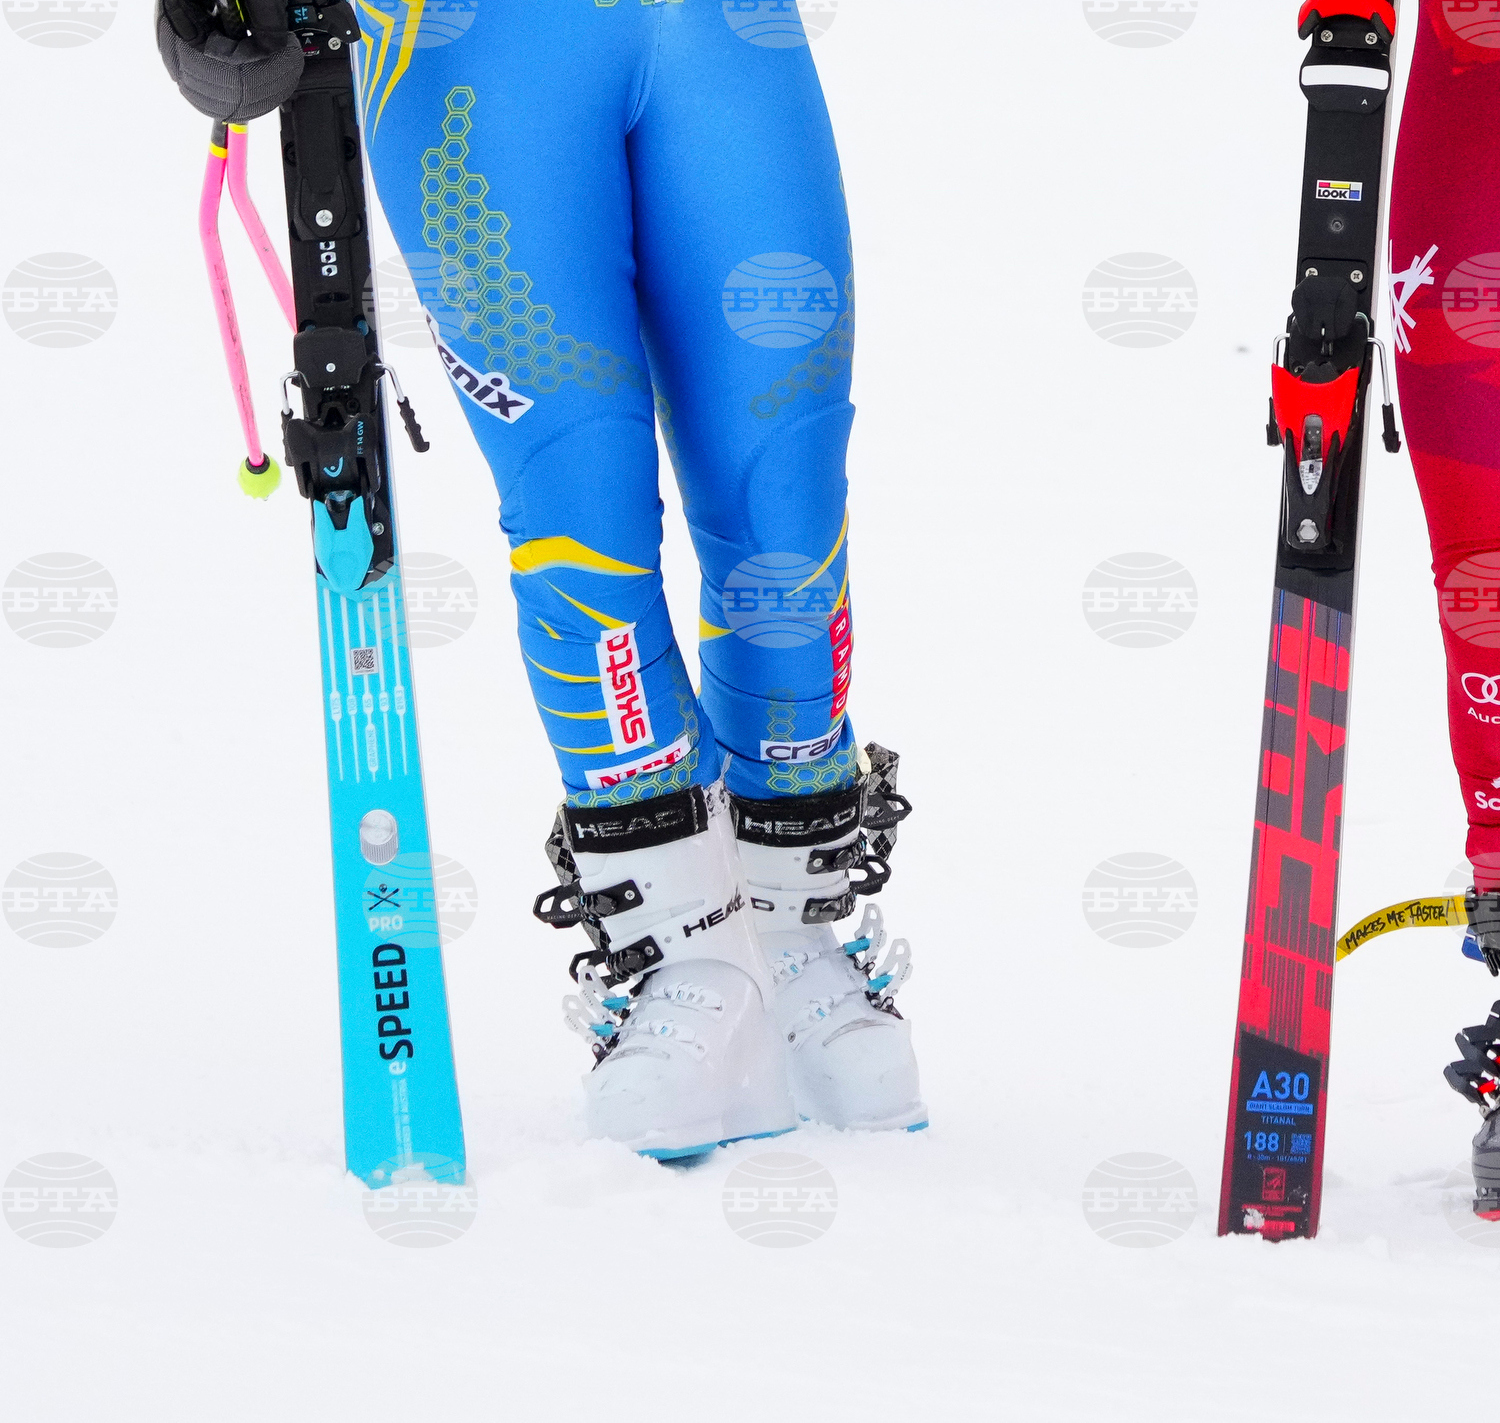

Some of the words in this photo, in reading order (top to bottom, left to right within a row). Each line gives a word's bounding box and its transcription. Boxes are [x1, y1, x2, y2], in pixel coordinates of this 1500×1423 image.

[1317, 189, 1349, 199] LOOK
[575, 808, 686, 840] HEAD
[745, 808, 856, 837] HEAD
[369, 915, 405, 932] PRO
[1344, 917, 1387, 950] MAKES
[1386, 910, 1405, 928] ME
[1403, 900, 1450, 926] FASTER!
[1250, 1070, 1311, 1102] A30
[1261, 1115, 1297, 1127] TITANAL
[1244, 1131, 1280, 1153] 188
